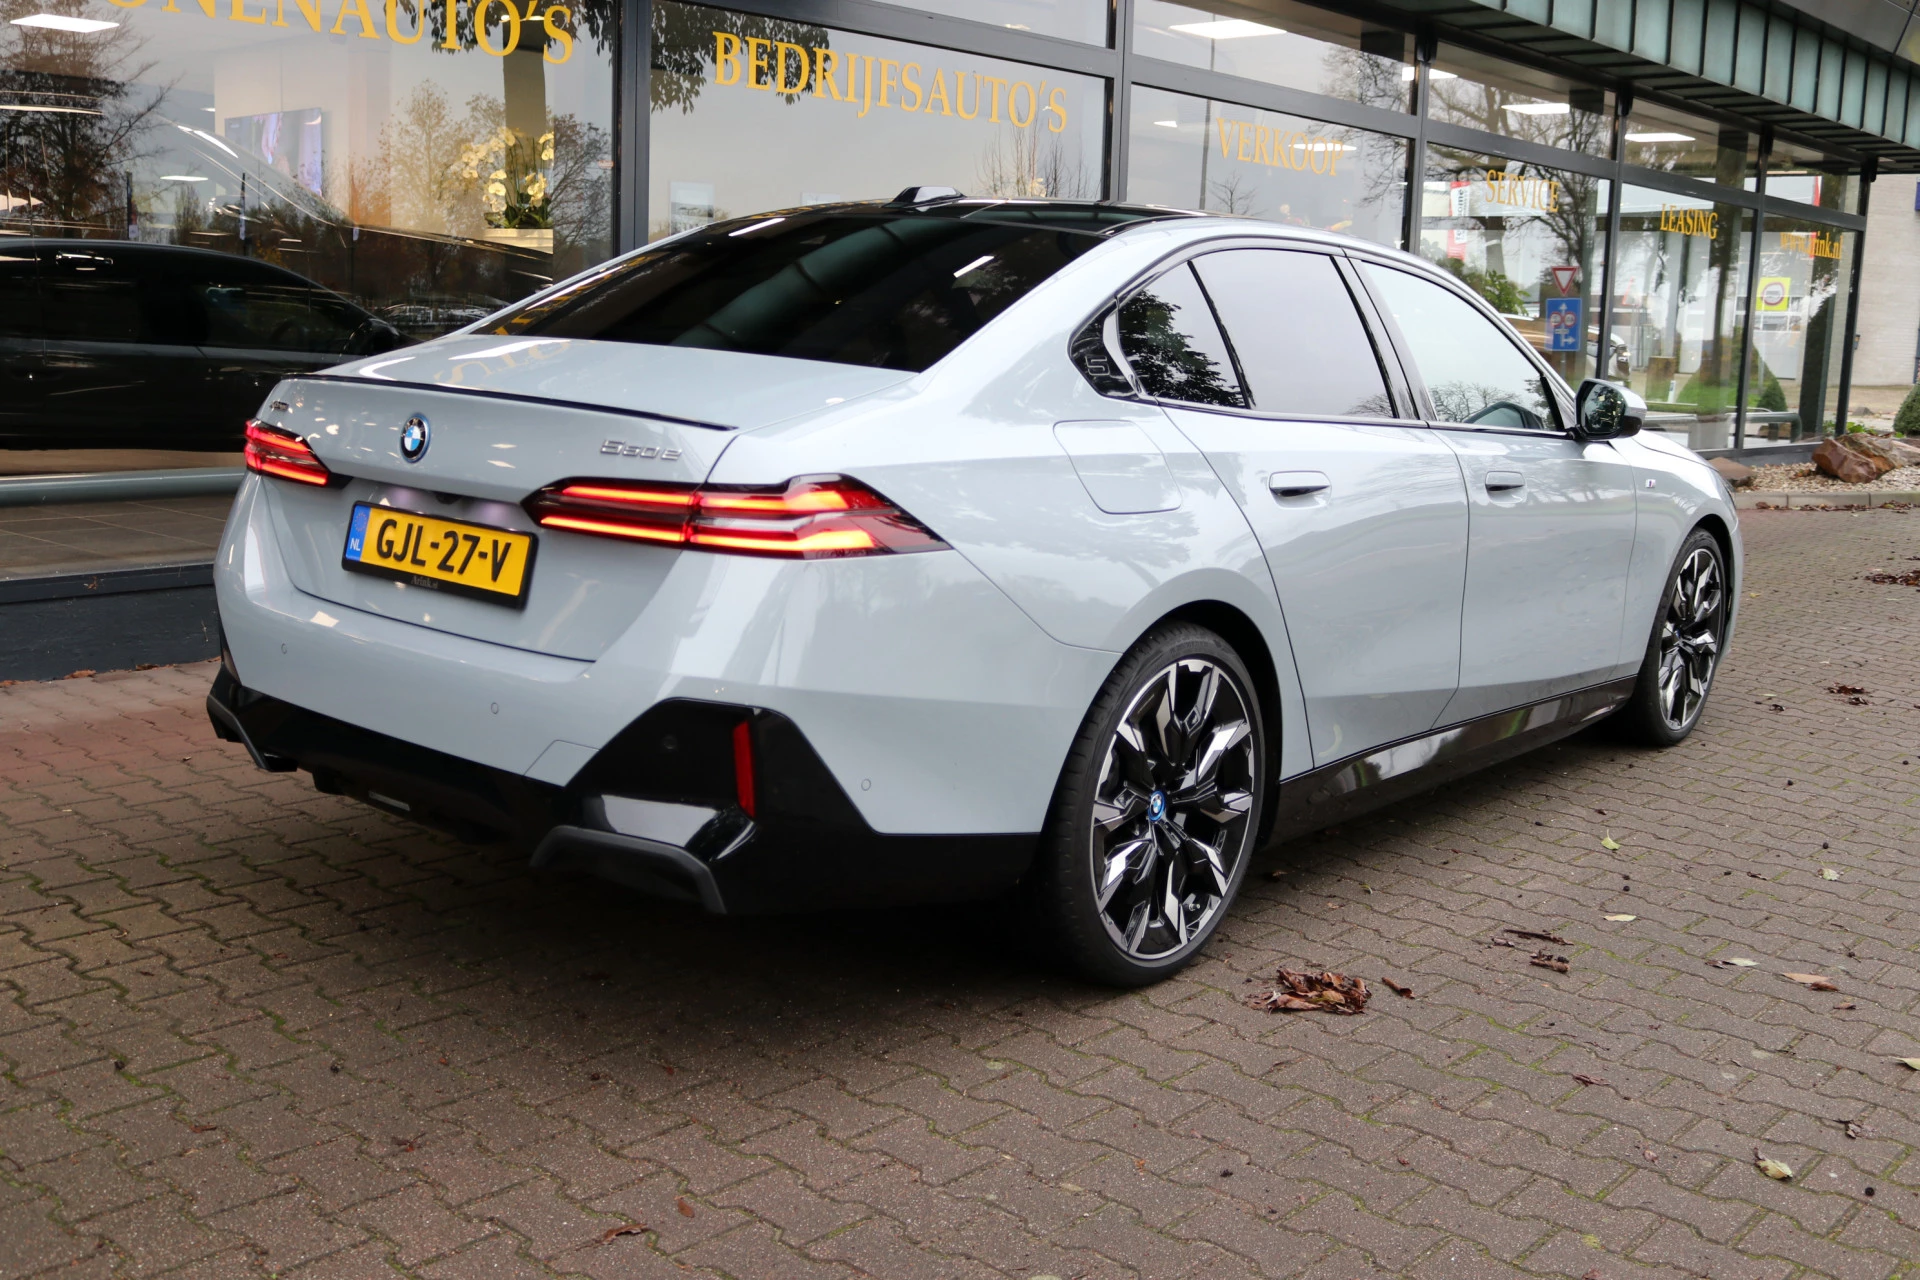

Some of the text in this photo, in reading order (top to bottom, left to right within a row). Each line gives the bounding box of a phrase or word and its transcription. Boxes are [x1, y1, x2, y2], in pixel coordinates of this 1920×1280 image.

[712, 31, 1067, 133] BEDRIJFSAUTO'S
[1215, 117, 1344, 177] VERKOOP
[1485, 169, 1559, 213] SERVICE
[1660, 203, 1718, 240] LEASING
[1084, 354, 1110, 376] 5
[350, 537, 361, 552] NL
[376, 518, 512, 583] GJL-27-V
